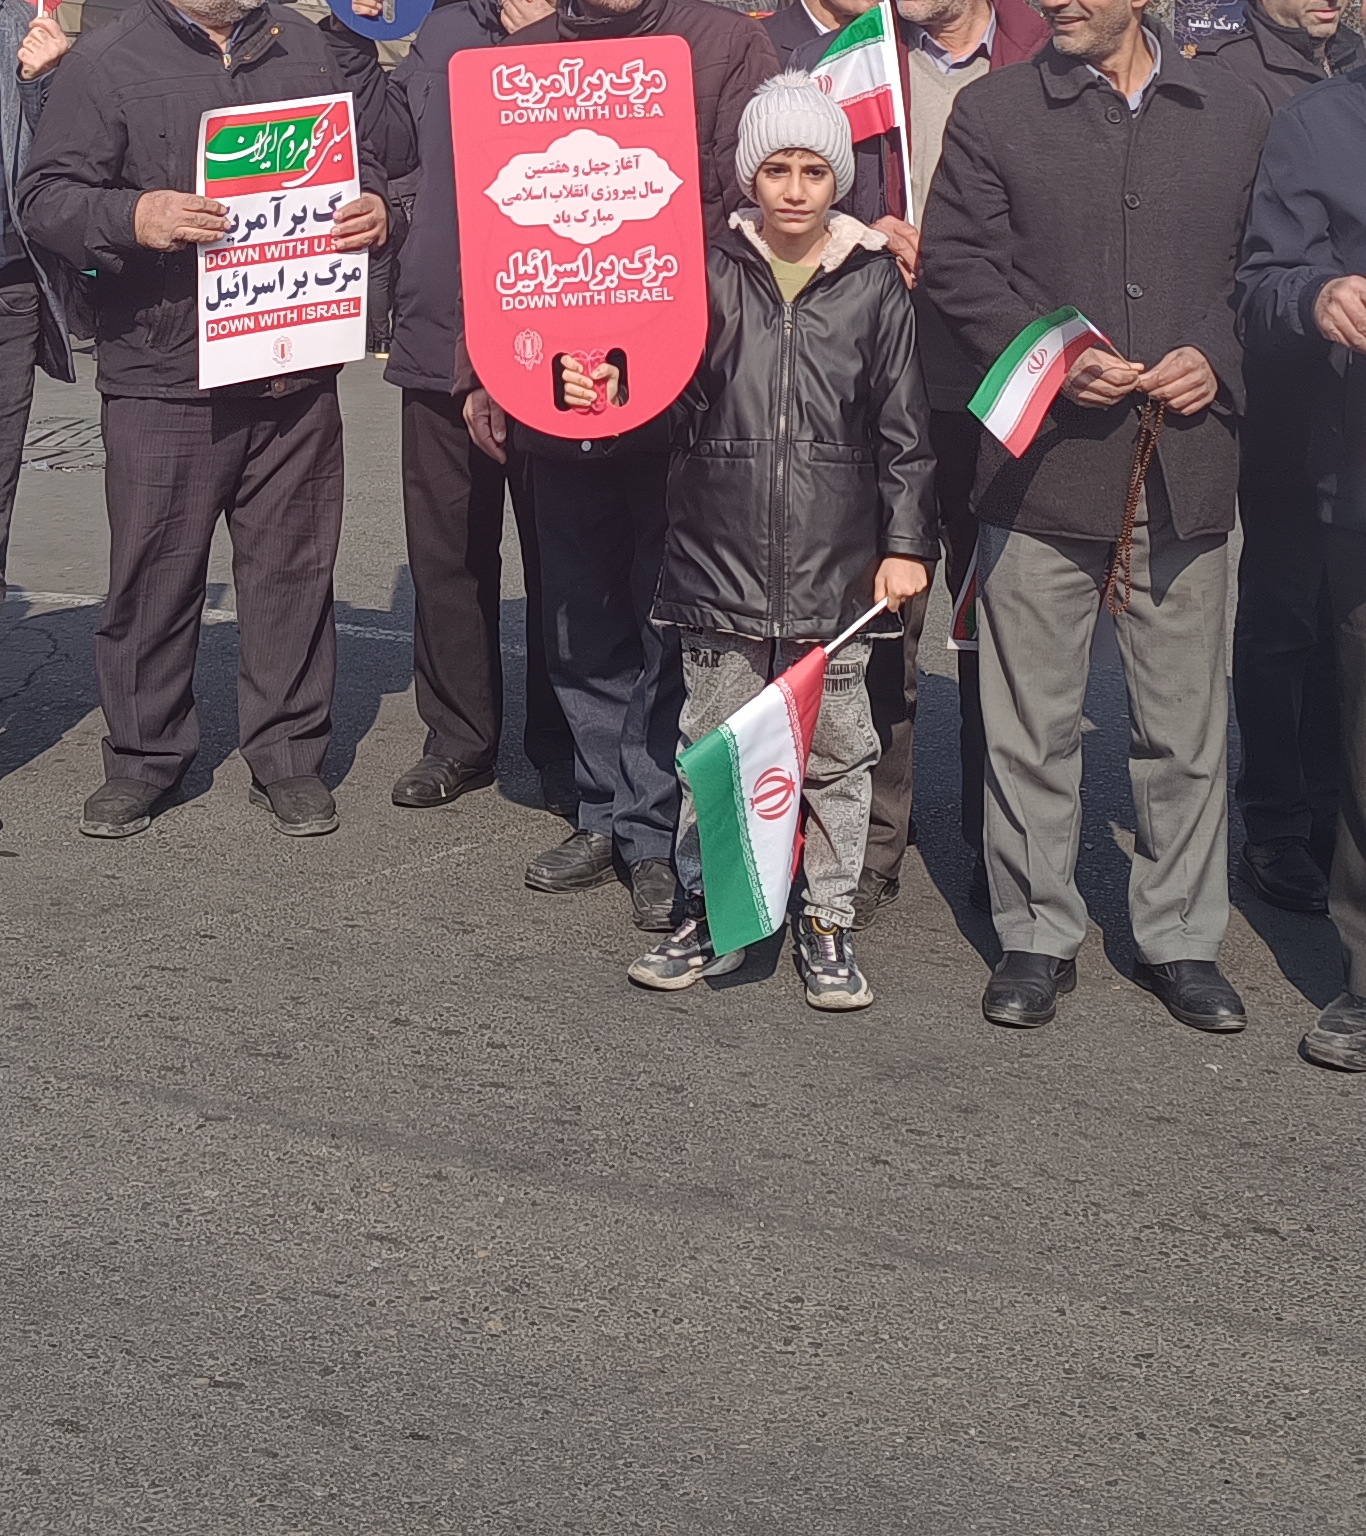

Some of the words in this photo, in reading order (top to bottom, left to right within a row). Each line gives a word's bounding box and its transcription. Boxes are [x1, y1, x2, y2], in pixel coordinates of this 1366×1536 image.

[492, 57, 584, 108] آمریکا
[576, 66, 609, 107] بر
[606, 58, 668, 104] مرگ
[500, 108, 558, 126] DOWN
[562, 105, 610, 122] WITH
[616, 103, 664, 120] U.S.A
[524, 161, 570, 181] هفتمین
[571, 164, 580, 179] و
[581, 159, 610, 178] چهل
[611, 154, 642, 176] آغاز
[501, 185, 548, 207] اسلامی
[549, 183, 589, 203] انقلاب
[590, 184, 637, 204] پیروزی
[638, 181, 664, 201] سال
[282, 204, 308, 238] بر
[552, 208, 571, 227] باد
[572, 208, 615, 226] مبارک
[206, 247, 260, 270] DOWN
[264, 239, 309, 259] WITH
[617, 245, 678, 289] مرگ
[287, 270, 309, 300] بر
[314, 258, 362, 293] مرگ
[496, 248, 593, 296] اسرائیل
[588, 253, 620, 290] بر
[205, 265, 286, 312] اسرائیل
[501, 294, 557, 311] DOWN
[561, 292, 606, 308] WITH
[610, 287, 674, 304] ISRAEL
[206, 316, 258, 338] DOWN
[258, 309, 299, 330] WITH
[301, 299, 360, 321] ISRAEL
